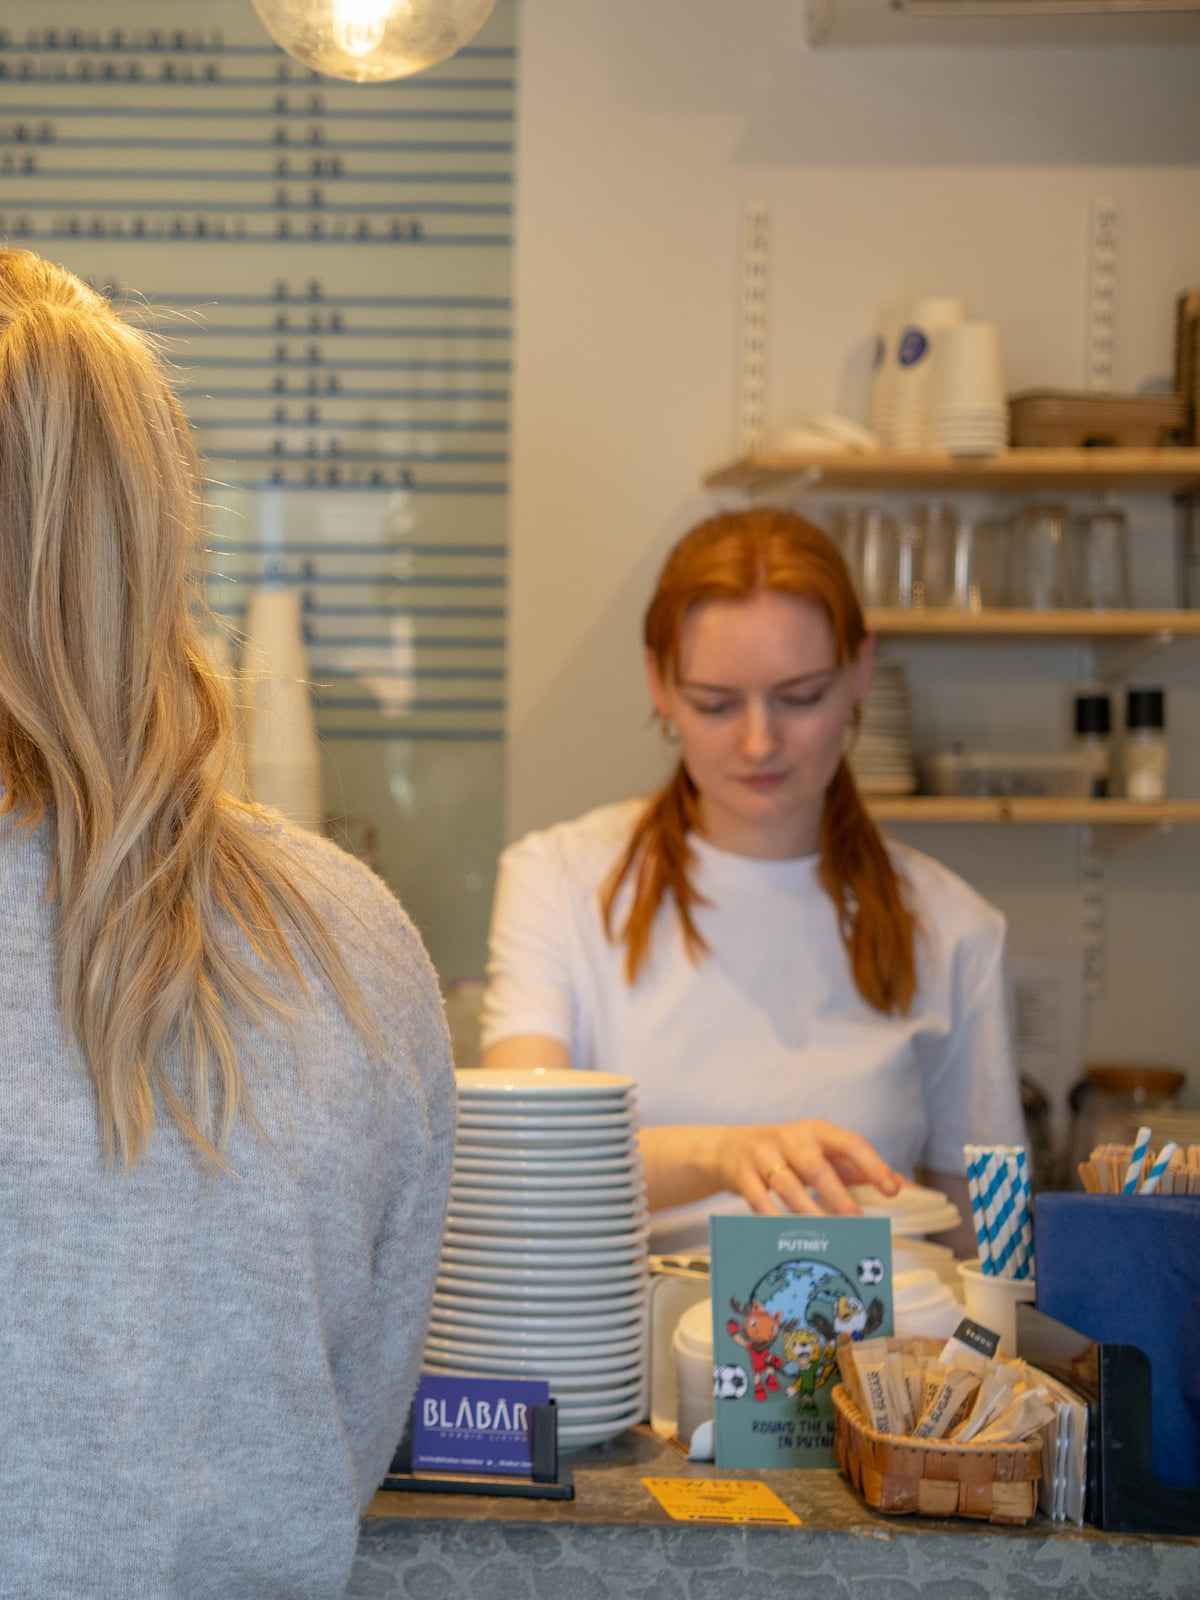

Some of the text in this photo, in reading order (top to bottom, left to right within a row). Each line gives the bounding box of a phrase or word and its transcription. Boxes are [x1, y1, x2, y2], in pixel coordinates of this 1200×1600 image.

[777, 1239, 829, 1252] PUTNEY
[930, 1384, 954, 1422] SUGAR
[752, 1420, 796, 1434] ROUND
[800, 1420, 821, 1433] THE
[777, 1436, 793, 1449] IN
